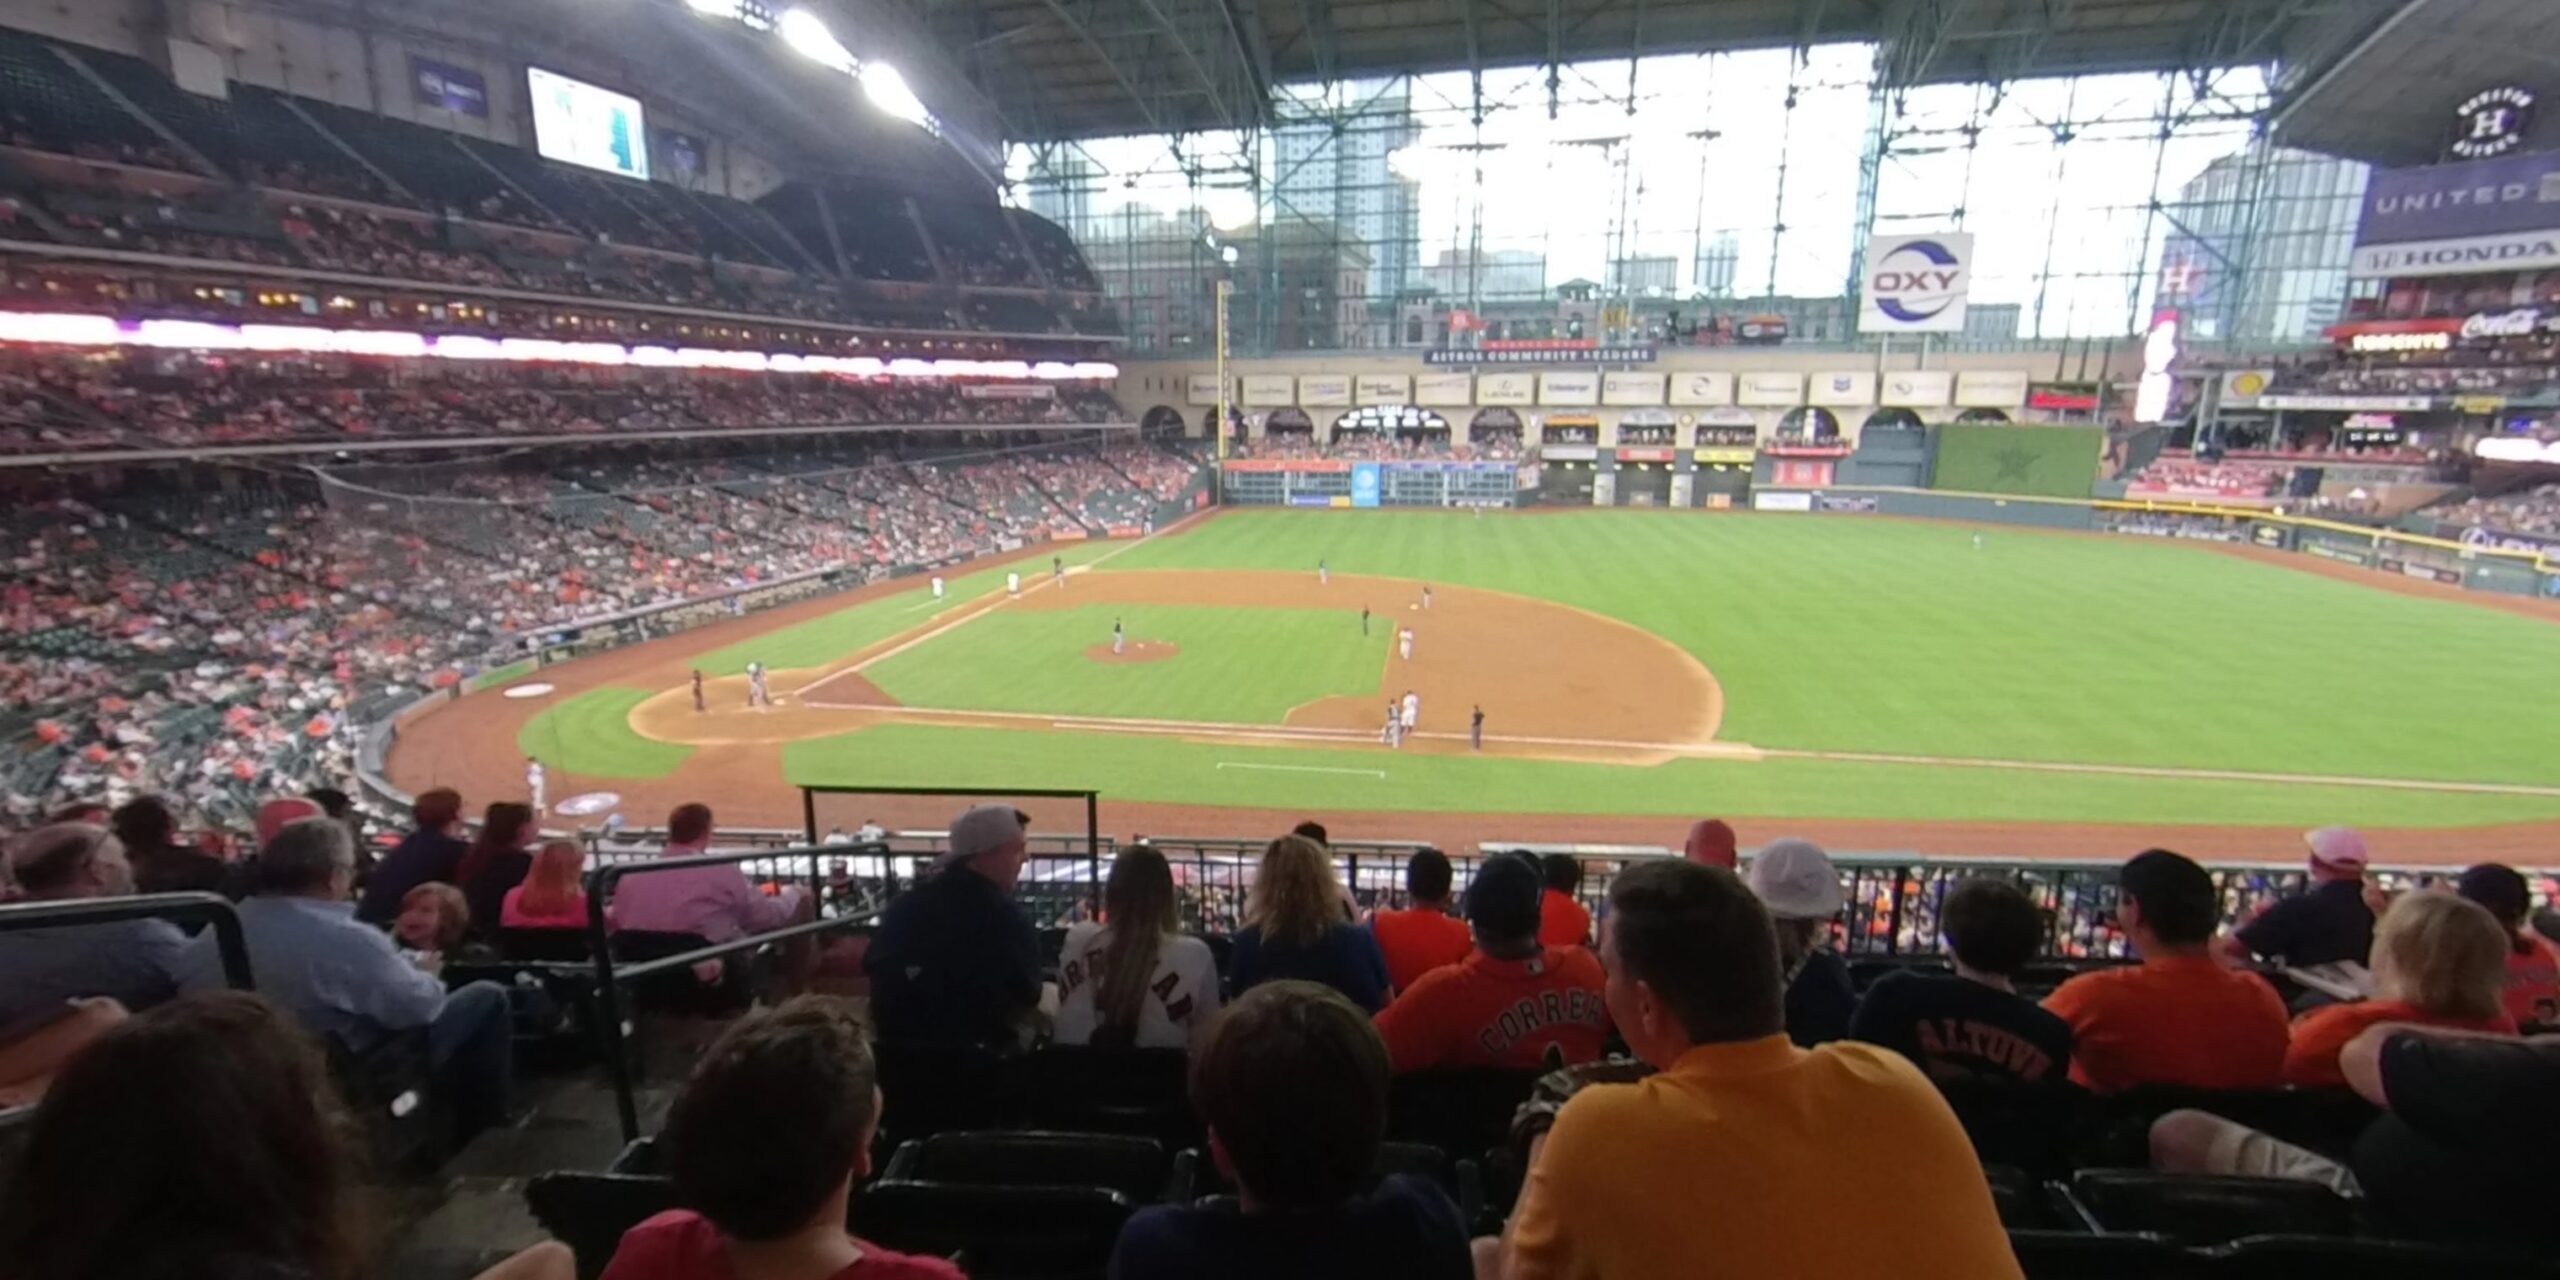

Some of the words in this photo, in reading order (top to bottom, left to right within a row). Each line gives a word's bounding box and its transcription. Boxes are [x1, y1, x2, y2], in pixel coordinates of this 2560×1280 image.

[2470, 108, 2507, 139] H
[2375, 183, 2527, 215] UNITED
[2404, 241, 2558, 266] HONDA
[1873, 270, 1959, 292] OXY
[1431, 350, 1483, 362] ASTROS
[1488, 350, 1577, 361] COMMUNITY
[1583, 350, 1649, 361] LEADERS
[1479, 987, 1602, 1054] CORREA
